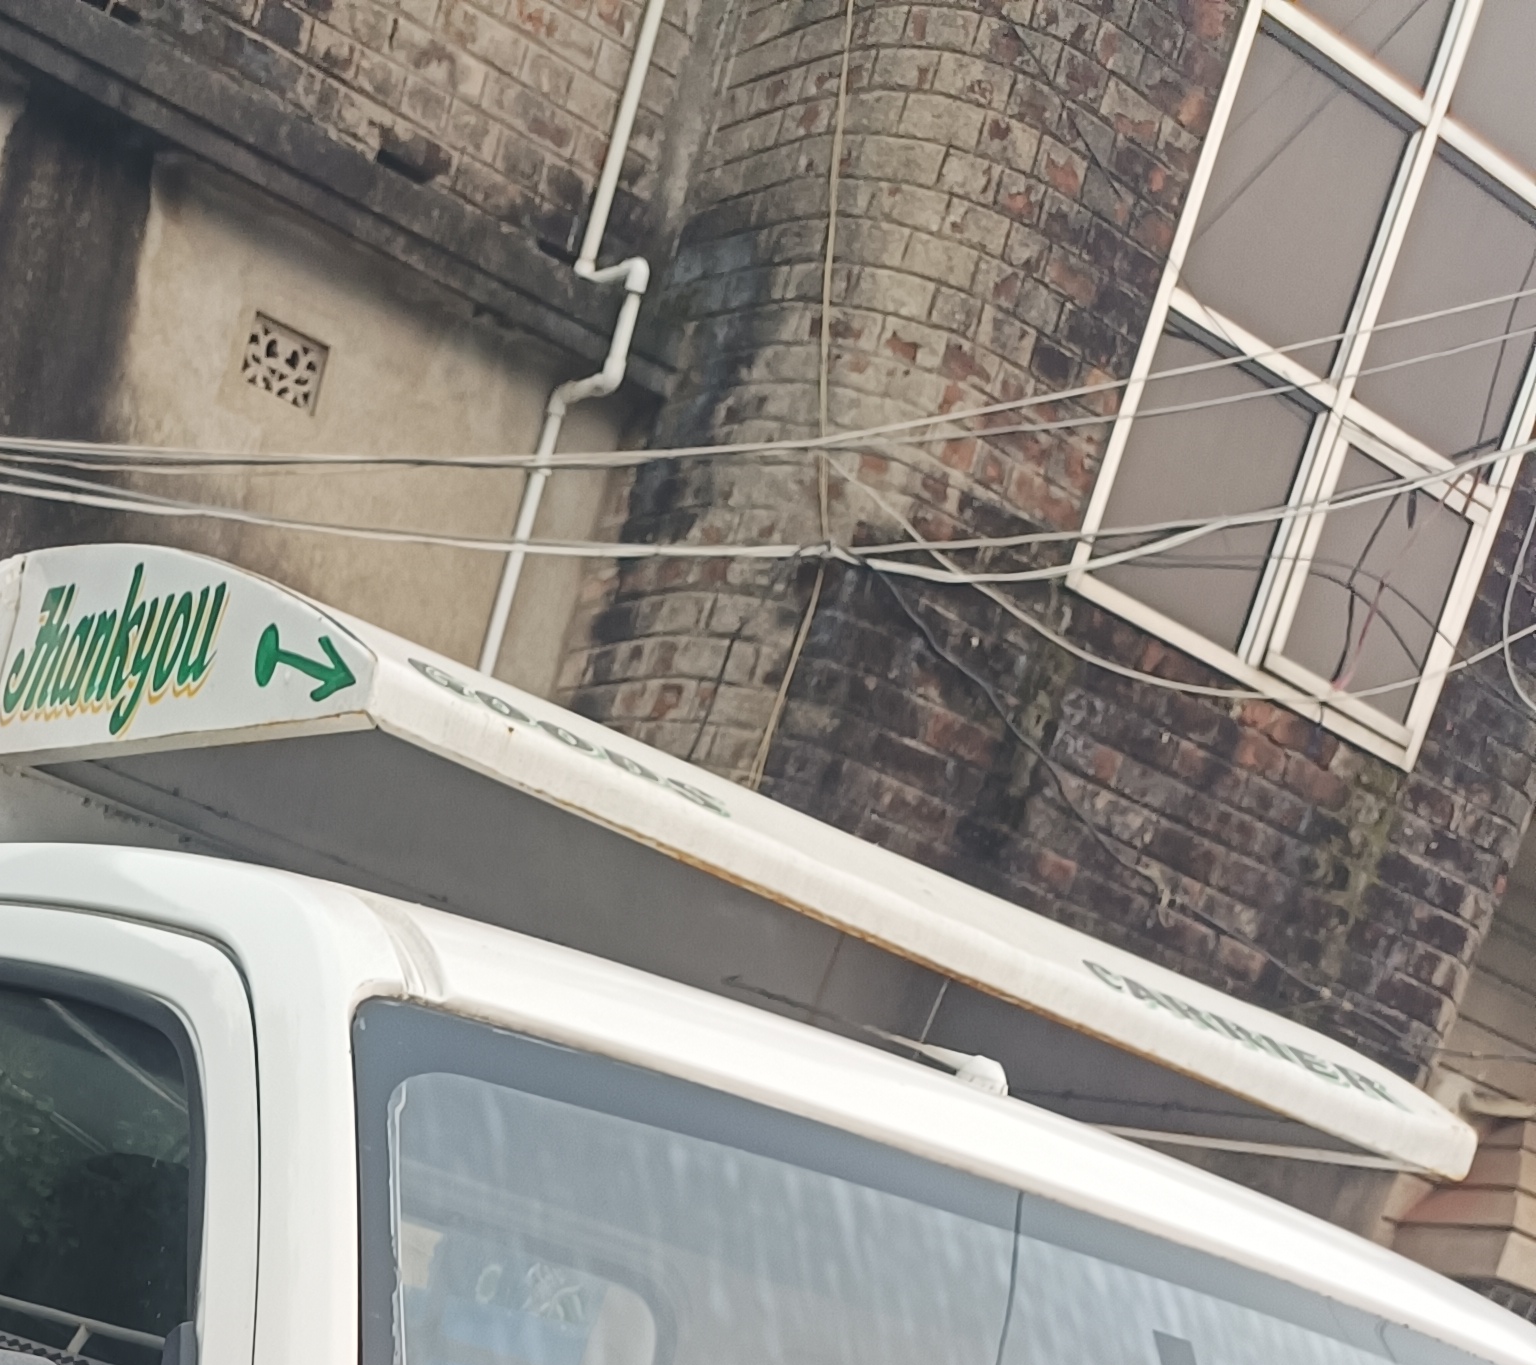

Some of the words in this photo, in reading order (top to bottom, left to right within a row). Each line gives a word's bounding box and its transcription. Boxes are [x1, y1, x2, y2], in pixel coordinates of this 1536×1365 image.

[0, 562, 230, 736] Thankyou
[408, 656, 732, 819] GOODS
[1080, 958, 1412, 1114] CARRIER
